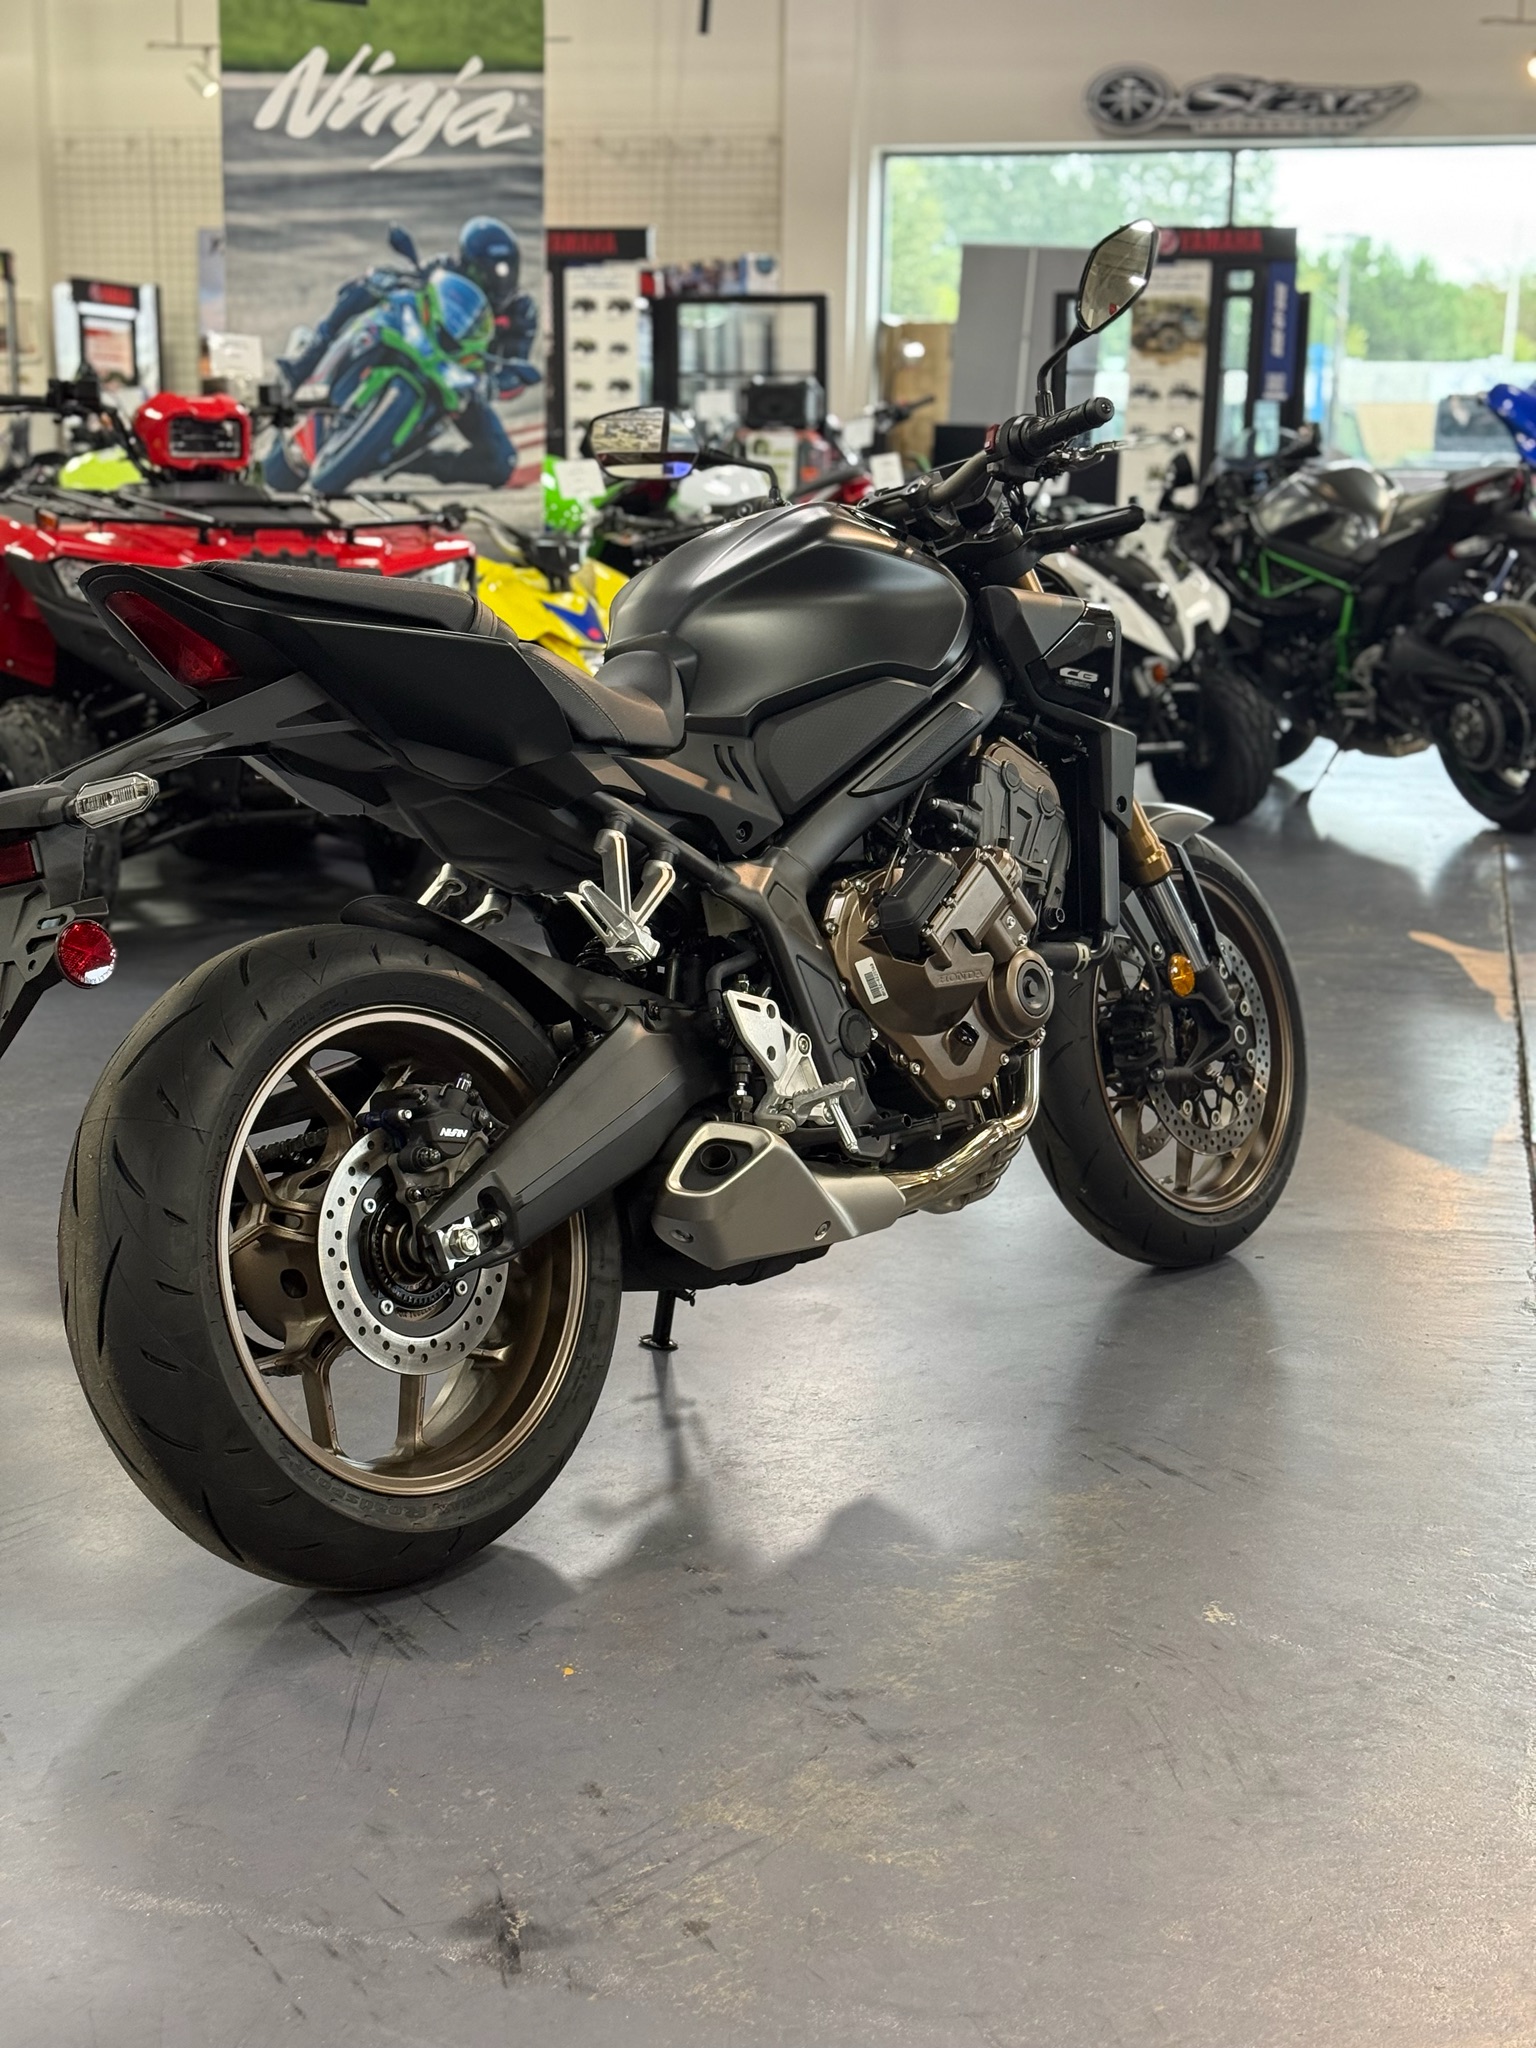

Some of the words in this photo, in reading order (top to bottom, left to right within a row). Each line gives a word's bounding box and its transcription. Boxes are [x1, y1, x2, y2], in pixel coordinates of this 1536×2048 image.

[253, 43, 532, 171] Ninja
[1059, 667, 1099, 683] CB
[939, 969, 985, 984] HONDA
